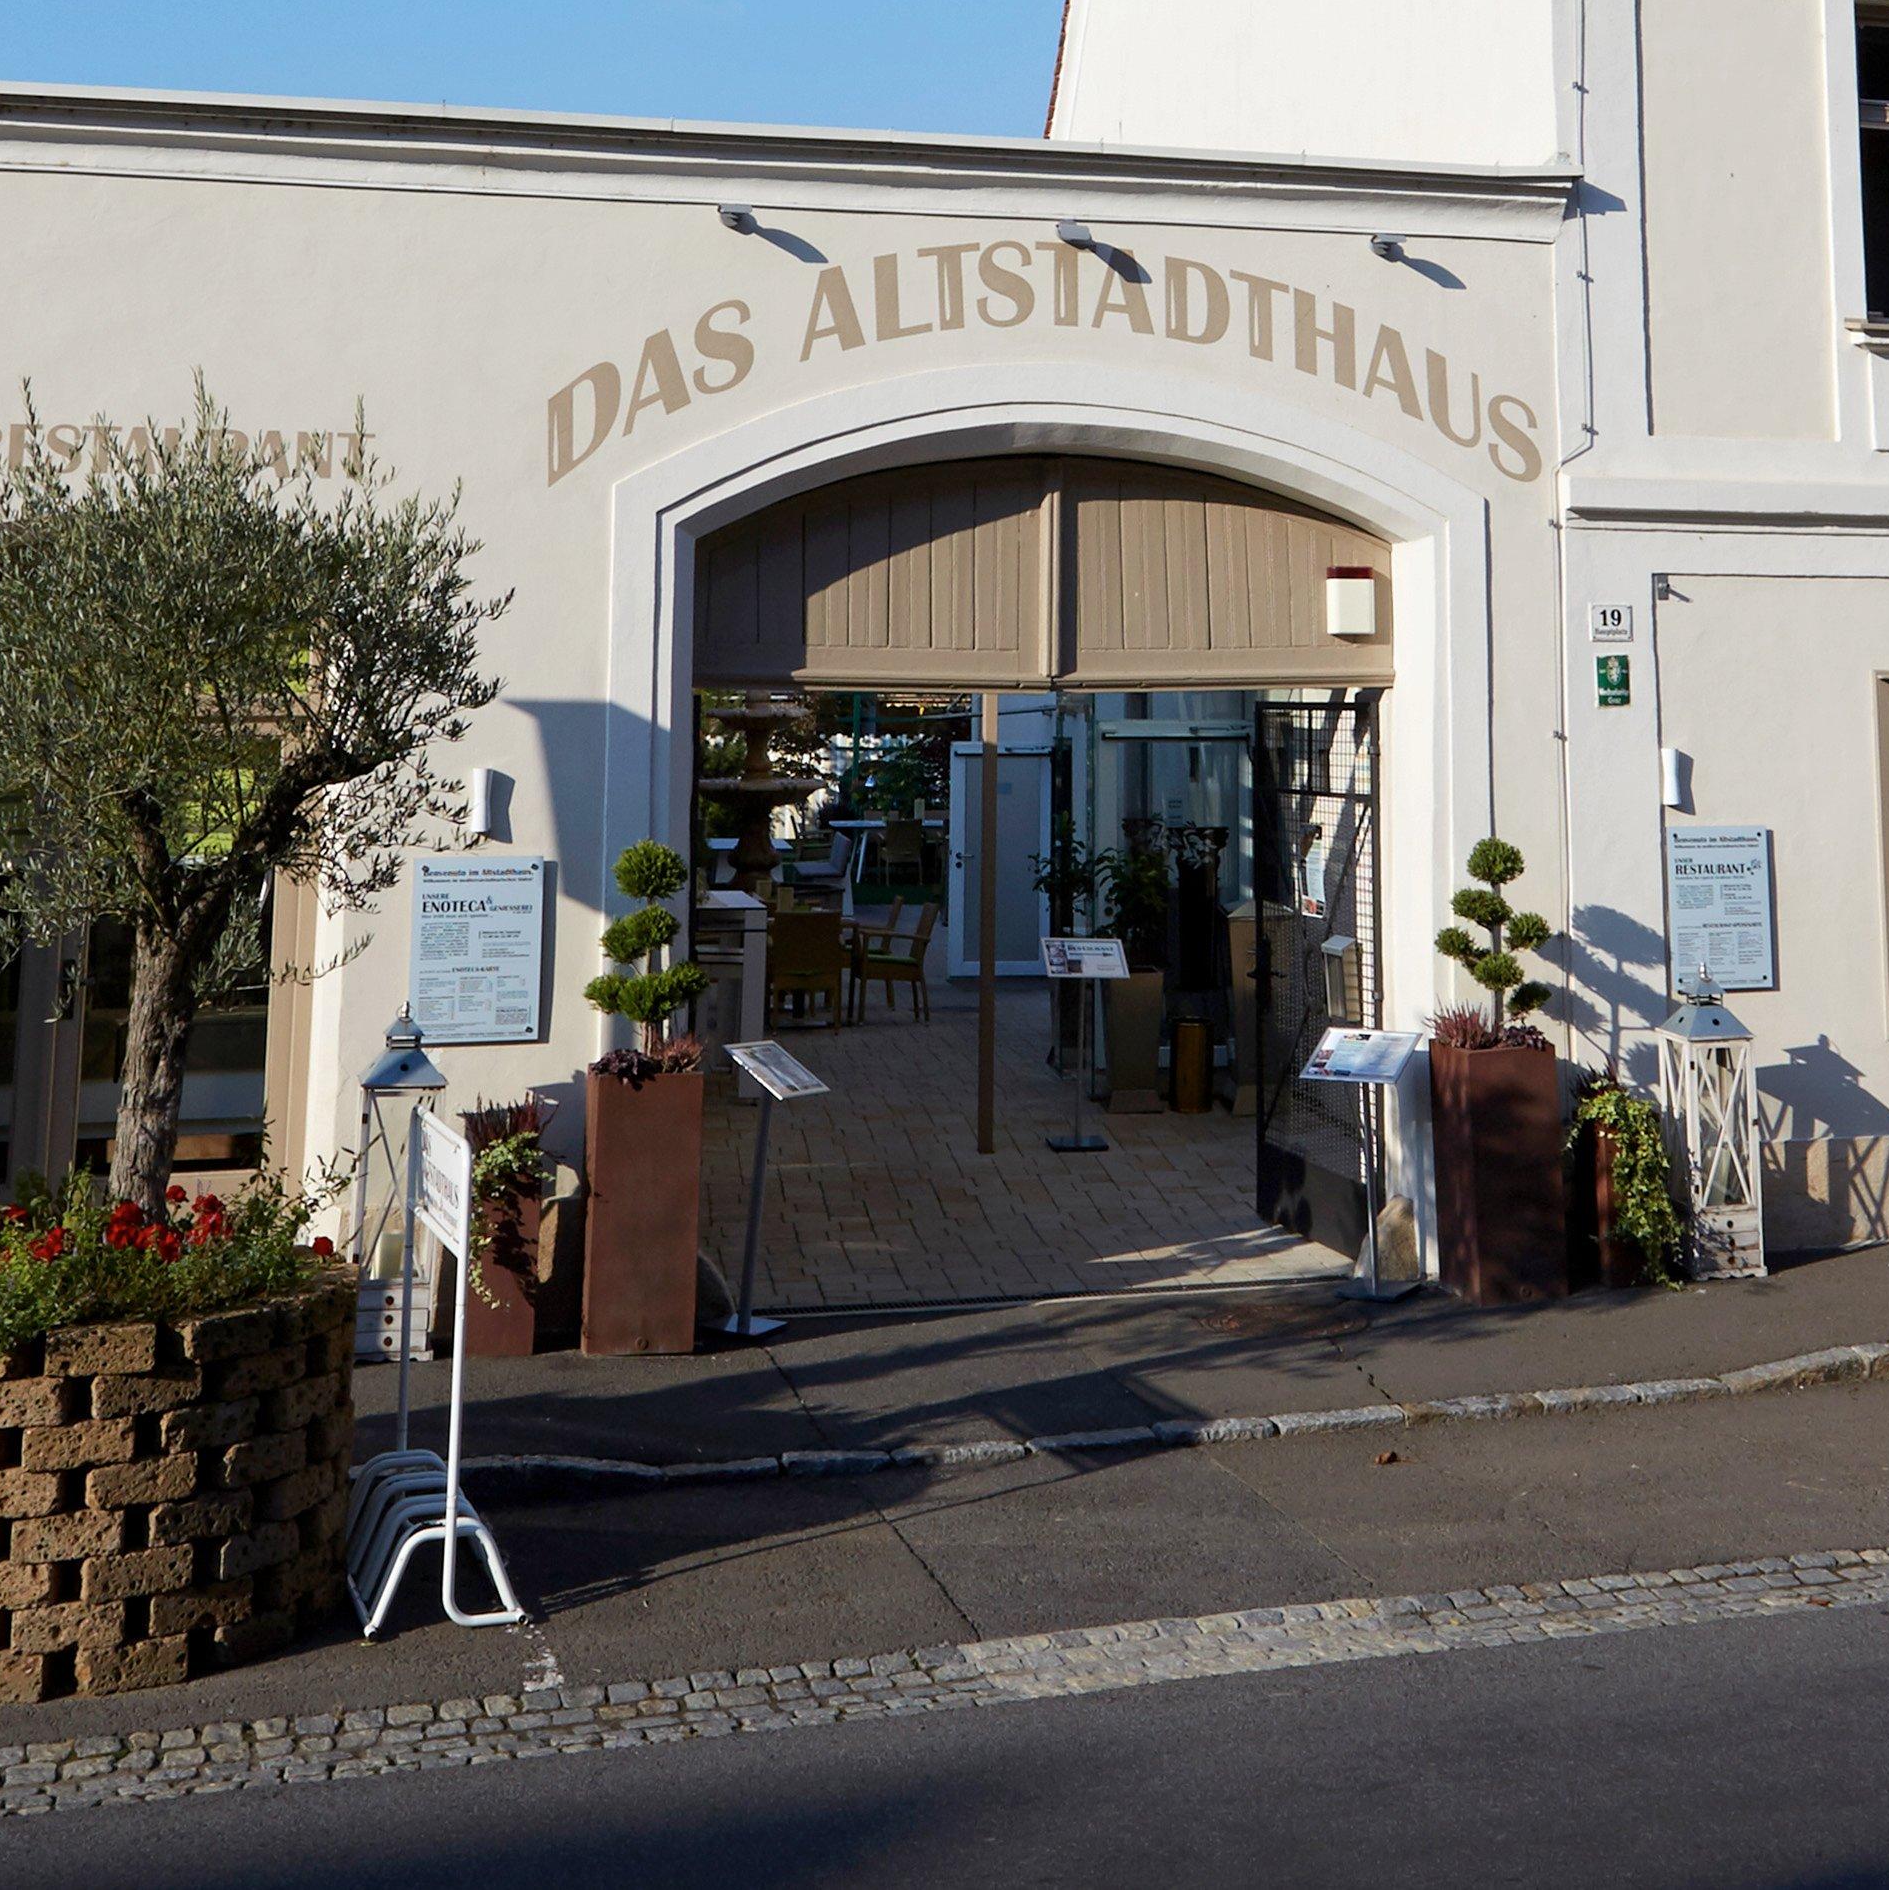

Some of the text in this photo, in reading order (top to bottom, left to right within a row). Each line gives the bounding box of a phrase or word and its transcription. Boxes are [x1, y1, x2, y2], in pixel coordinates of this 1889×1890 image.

[547, 240, 1543, 487] DAS ALTSTADTHAUS
[1599, 609, 1622, 627] 19
[1675, 863, 1745, 875] RESTAURANT
[422, 900, 486, 913] ENOTECA
